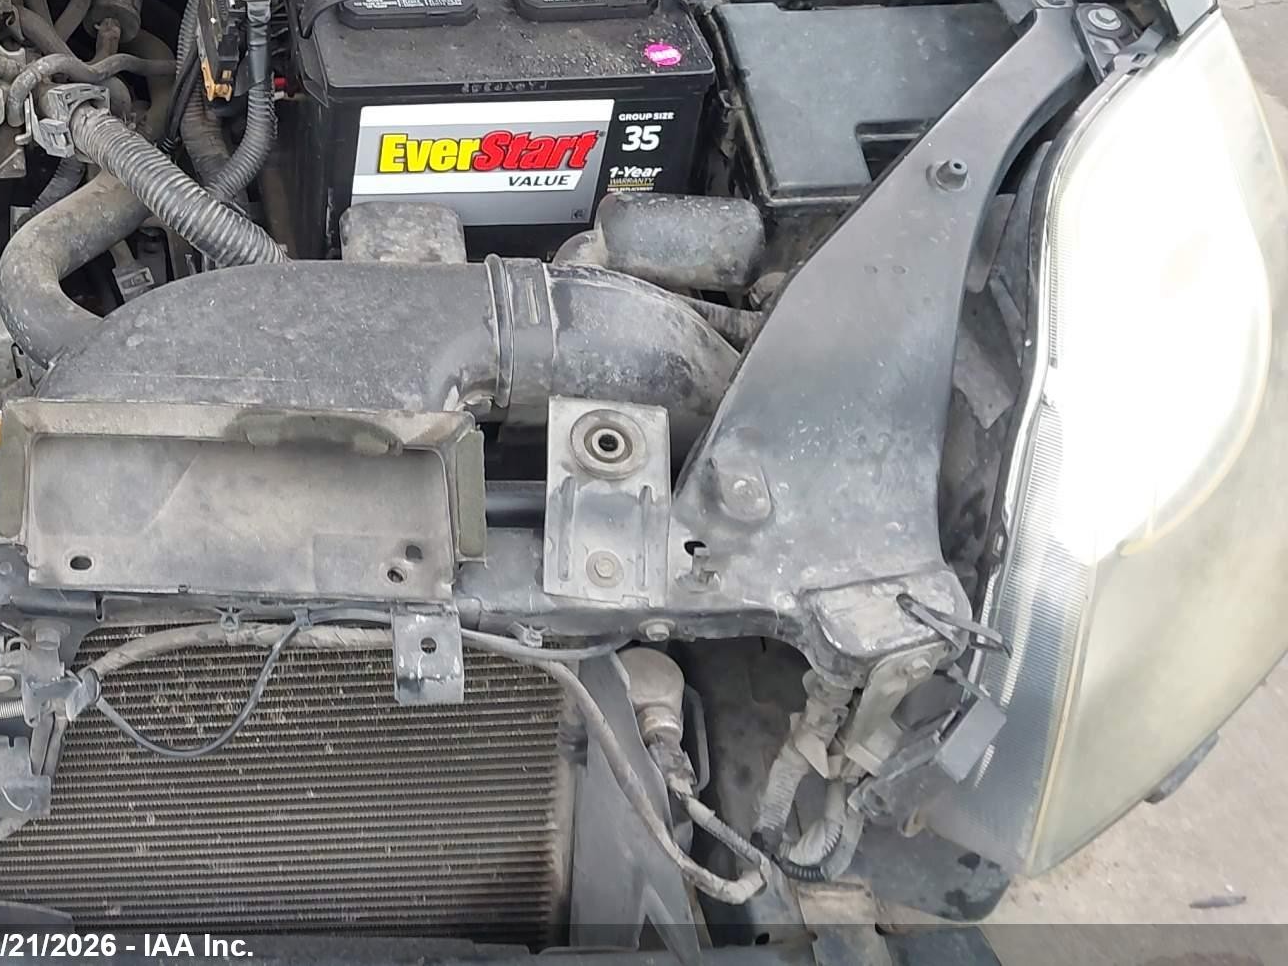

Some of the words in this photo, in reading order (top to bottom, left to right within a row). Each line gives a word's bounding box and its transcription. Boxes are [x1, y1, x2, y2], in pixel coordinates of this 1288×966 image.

[619, 113, 652, 121] GROUP
[653, 112, 674, 120] SIZE
[622, 125, 662, 151] 35
[378, 130, 599, 172] EverStart
[609, 166, 662, 178] 1-Year
[508, 175, 571, 186] VALUE
